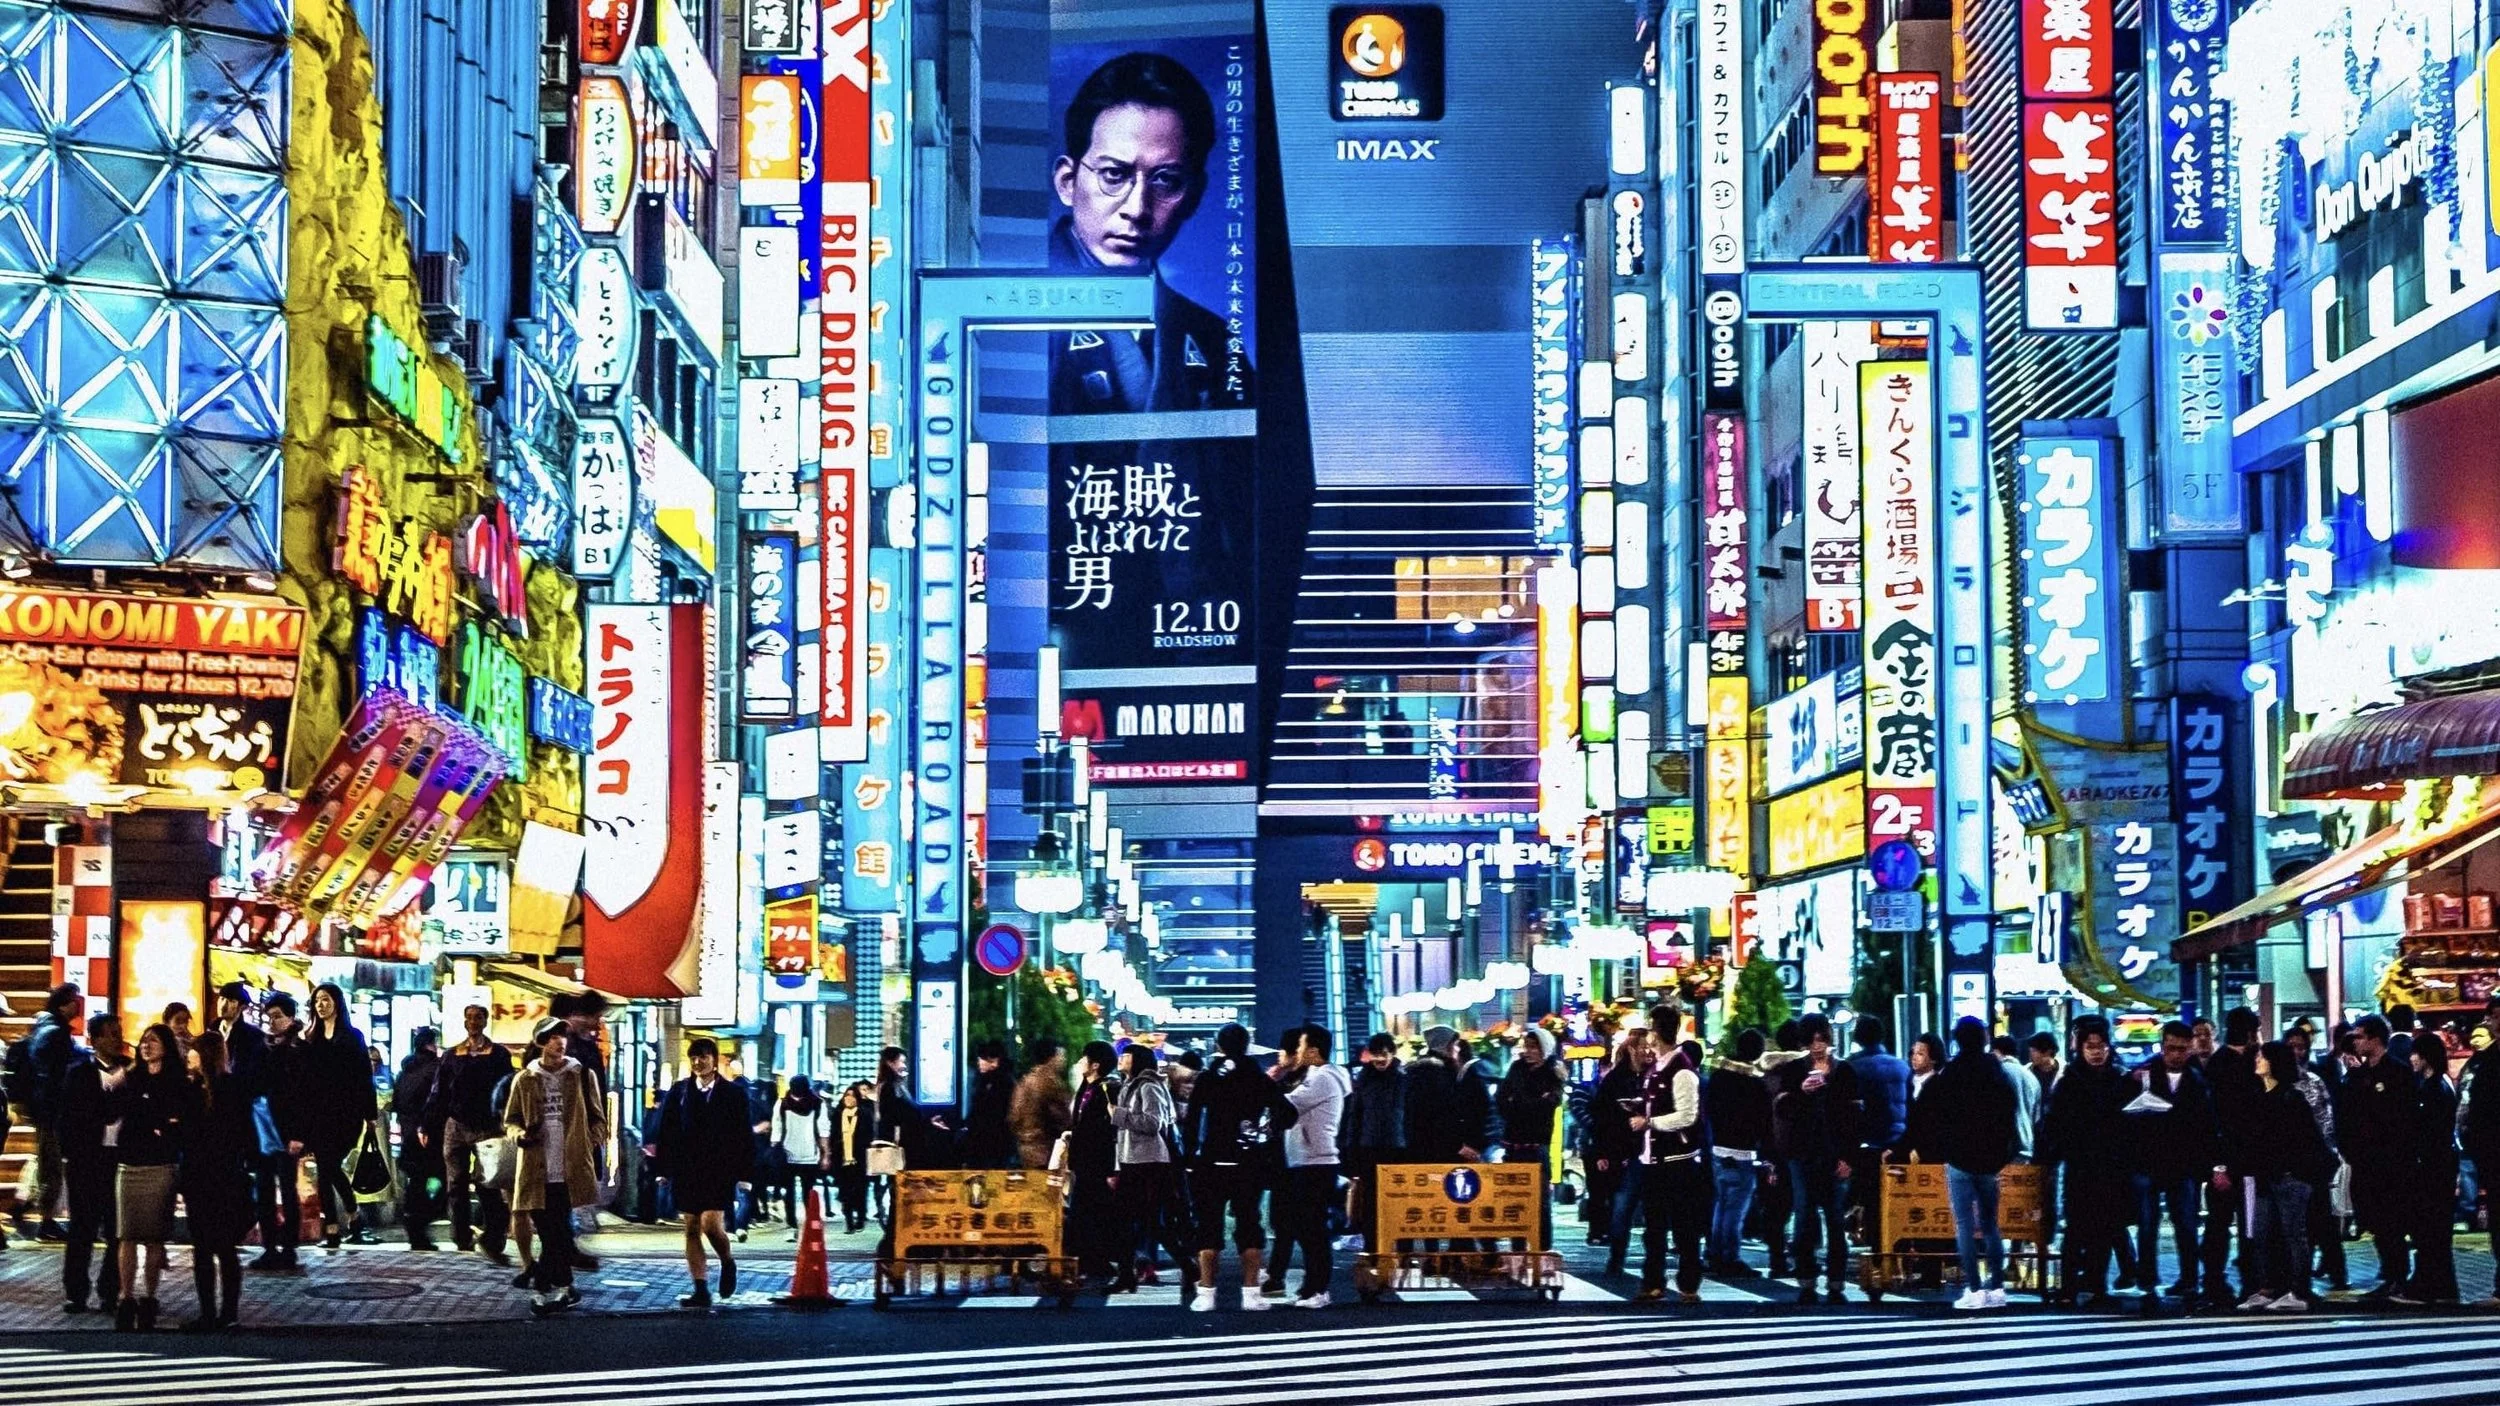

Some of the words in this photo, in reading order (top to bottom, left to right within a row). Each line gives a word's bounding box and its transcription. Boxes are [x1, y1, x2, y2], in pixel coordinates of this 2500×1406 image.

[1713, 64, 1727, 80] &
[1337, 140, 1440, 161] IMAX
[2167, 37, 2206, 229] かんかん商店
[2315, 181, 2355, 244] Don
[821, 214, 857, 294] BIC
[821, 312, 856, 449] DRUG
[1065, 461, 1202, 519] 海賊と
[1886, 374, 1920, 567] きんくら酒場
[2182, 473, 2223, 500] 5F
[925, 376, 954, 681] GODZILLA
[1066, 519, 1190, 554] よばれた
[583, 547, 611, 564] B1
[2034, 446, 2100, 691] カラオケ
[1064, 557, 1114, 610] 男
[193, 606, 302, 650] YAKI
[1153, 600, 1241, 634] 12.10
[1154, 634, 1238, 648] ROADSHOW
[1711, 631, 1745, 651] 4F
[170, 673, 183, 691] 2
[1711, 653, 1745, 672] 3F
[596, 623, 634, 795] トラノコ
[1116, 702, 1245, 736] MARUHAN
[1872, 618, 1936, 778] 金の蔵
[924, 721, 953, 864] ROAD
[1872, 794, 1923, 836] 2F
[2184, 708, 2227, 899] カラオケ
[2113, 820, 2160, 980] カラオケ
